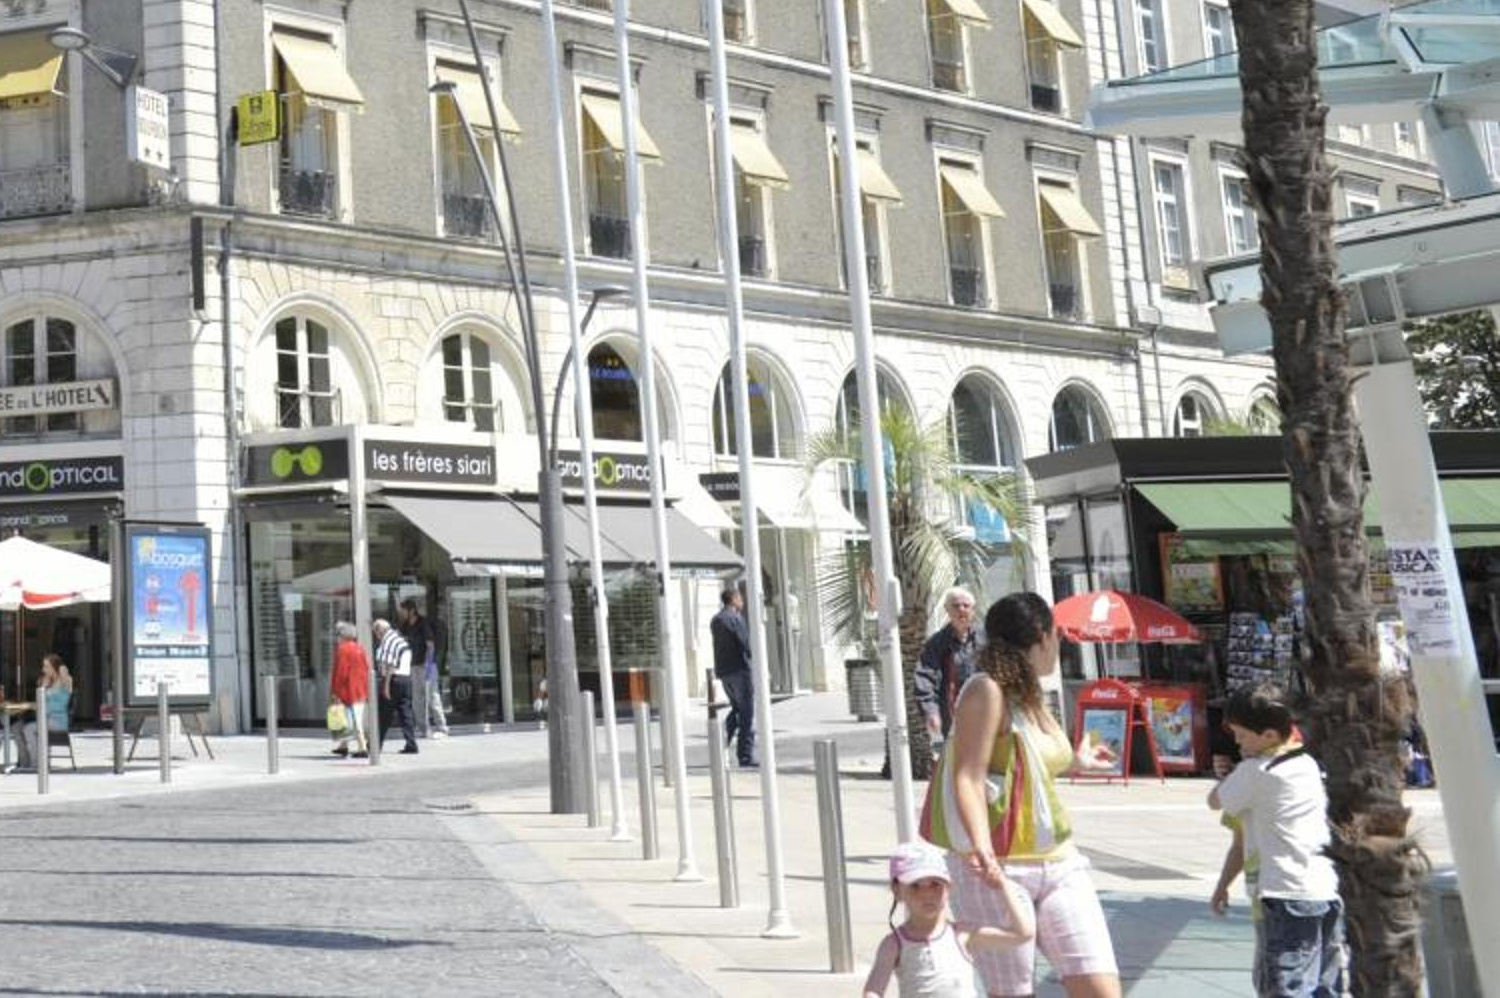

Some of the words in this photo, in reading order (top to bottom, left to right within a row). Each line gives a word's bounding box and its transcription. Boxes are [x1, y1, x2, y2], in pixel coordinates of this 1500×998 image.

[372, 449, 399, 471] les
[402, 450, 453, 474] frères
[457, 454, 491, 476] siari
